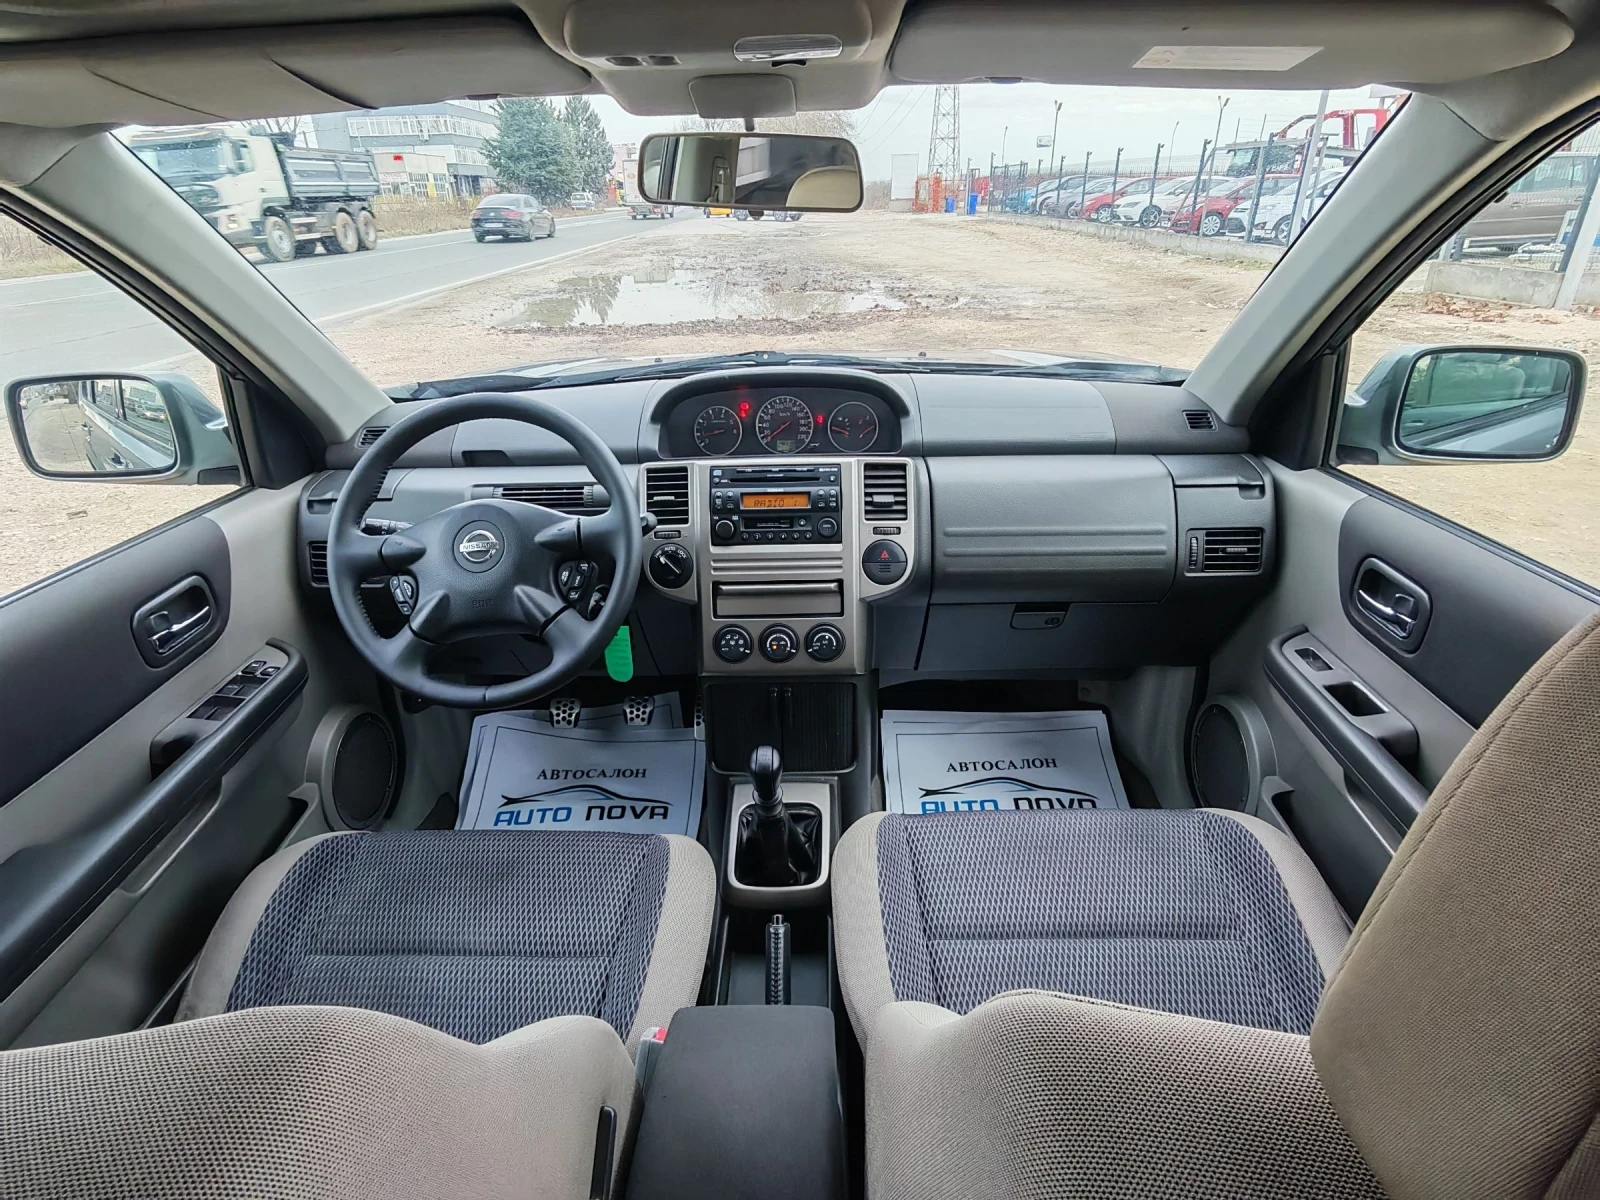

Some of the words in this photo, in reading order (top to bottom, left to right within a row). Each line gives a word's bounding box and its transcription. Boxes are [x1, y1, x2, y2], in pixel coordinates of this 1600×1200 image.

[753, 499, 785, 508] RADIO
[462, 542, 494, 551] NISSAN
[677, 548, 688, 559] LOCK
[946, 757, 1059, 773] АВТОСАЛОН
[536, 767, 648, 781] АВТОСАЛОН
[921, 798, 1000, 815] AUTO
[493, 806, 573, 827] AUTO
[585, 804, 669, 822] NOVA
